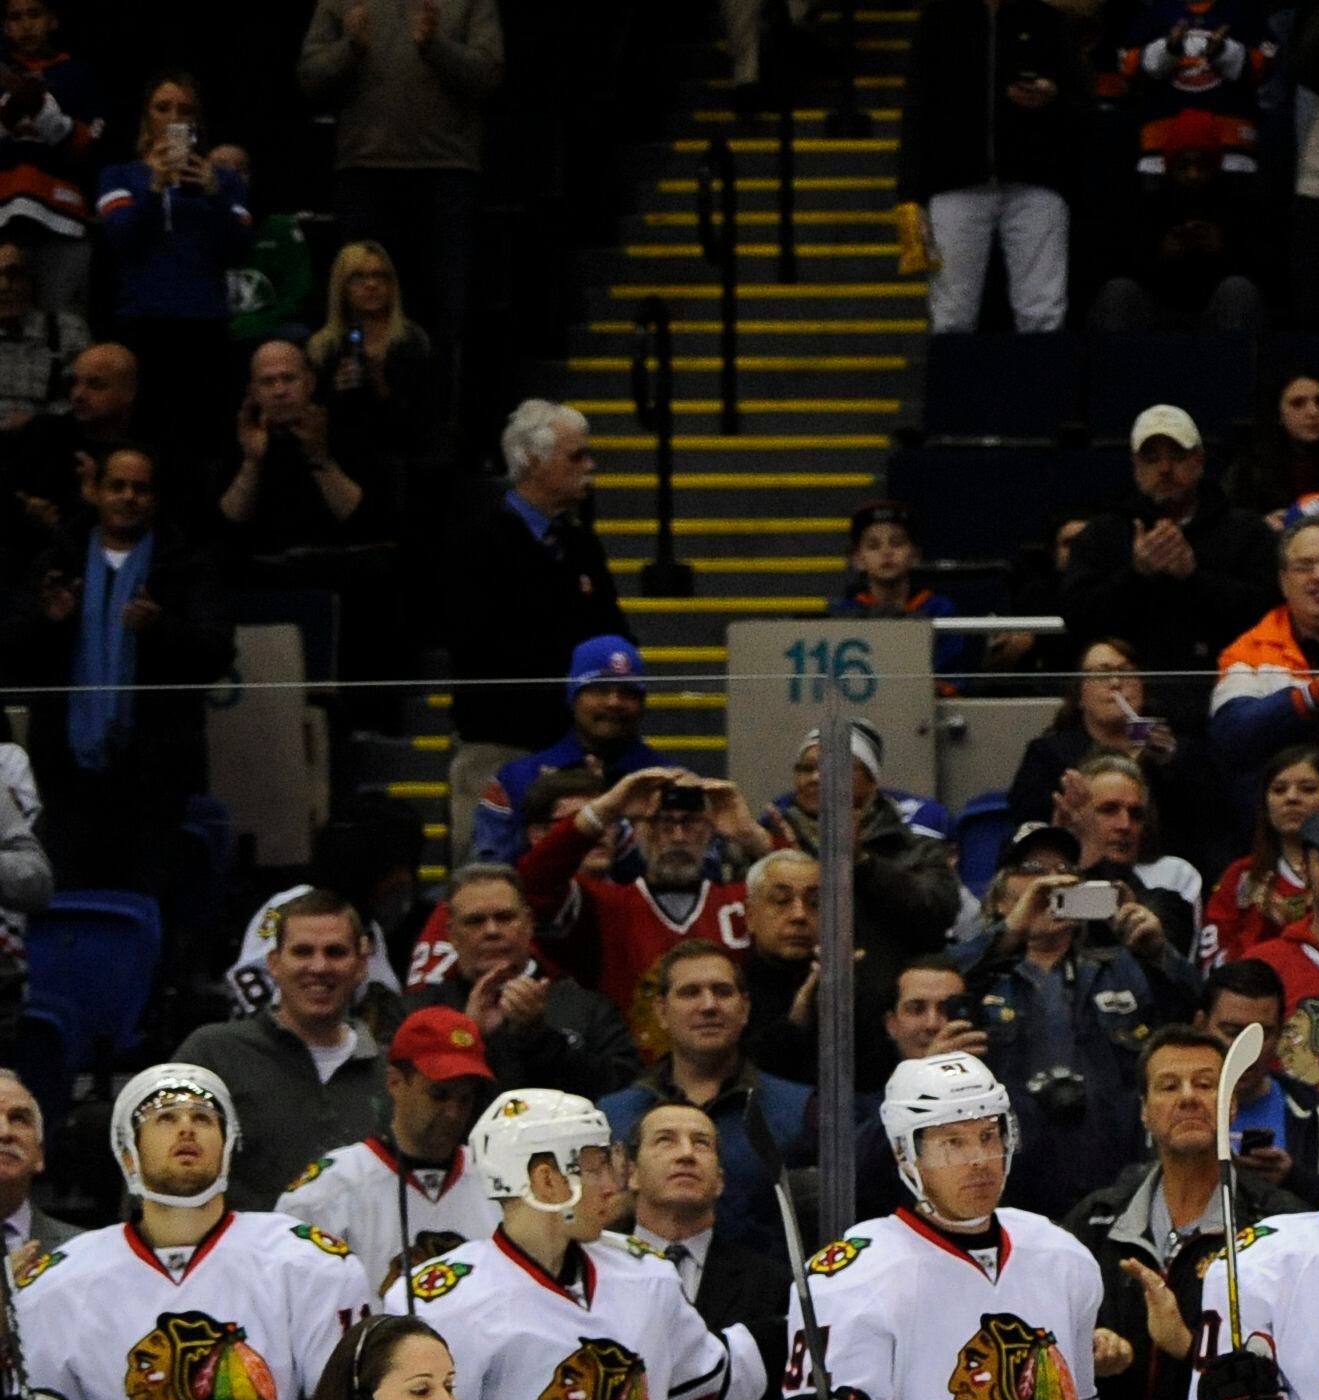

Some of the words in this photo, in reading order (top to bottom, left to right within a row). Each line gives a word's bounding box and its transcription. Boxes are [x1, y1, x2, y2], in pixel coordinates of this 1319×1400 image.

[785, 638, 877, 704] 116
[718, 901, 751, 950] C
[406, 940, 460, 986] 27
